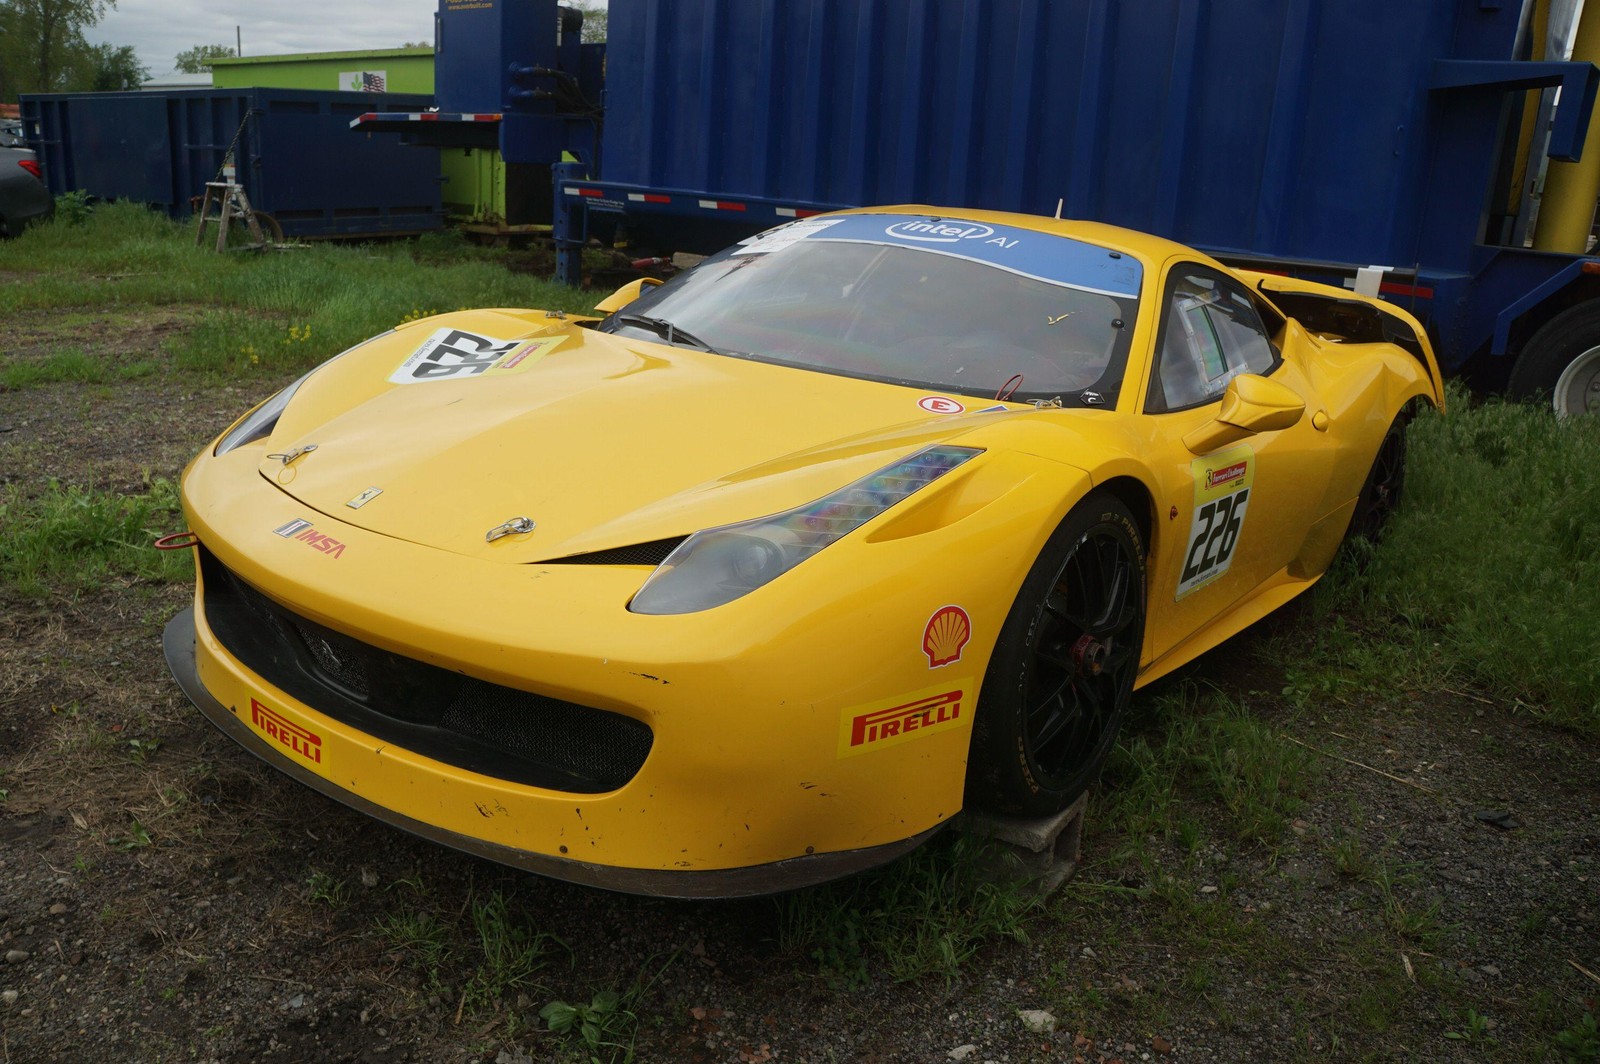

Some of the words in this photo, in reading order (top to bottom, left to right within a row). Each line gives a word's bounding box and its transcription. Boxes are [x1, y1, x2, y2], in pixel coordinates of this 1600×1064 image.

[901, 220, 977, 238] intel
[985, 236, 1020, 249] AI
[931, 400, 950, 411] E
[294, 528, 346, 560] IMSA
[1180, 488, 1249, 584] 226
[250, 696, 322, 764] PIRELLI
[850, 689, 963, 747] PIRELLI
